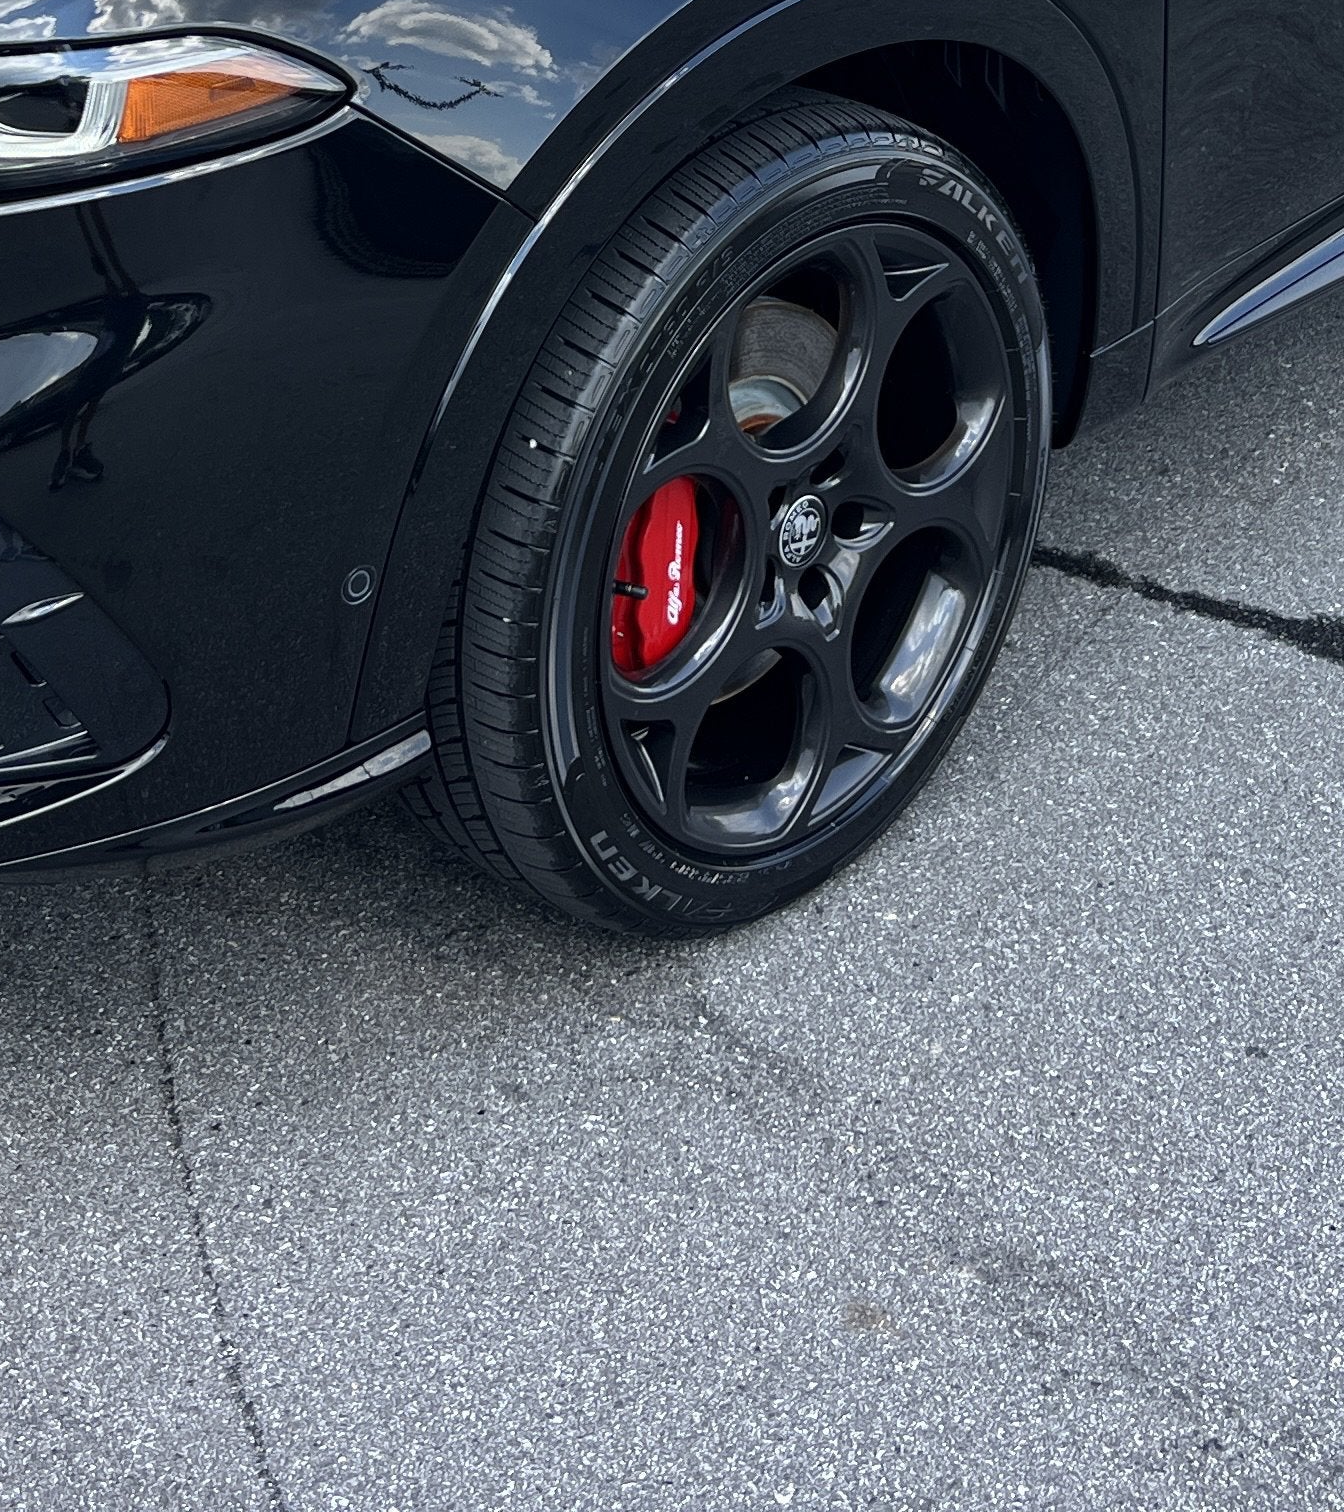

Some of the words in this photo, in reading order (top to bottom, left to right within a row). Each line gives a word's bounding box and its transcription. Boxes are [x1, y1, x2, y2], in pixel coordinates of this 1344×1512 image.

[919, 168, 1028, 285] FALKEN
[667, 519, 684, 581] Romeo
[667, 582, 683, 625] Alfa
[590, 830, 732, 918] FALKEN
